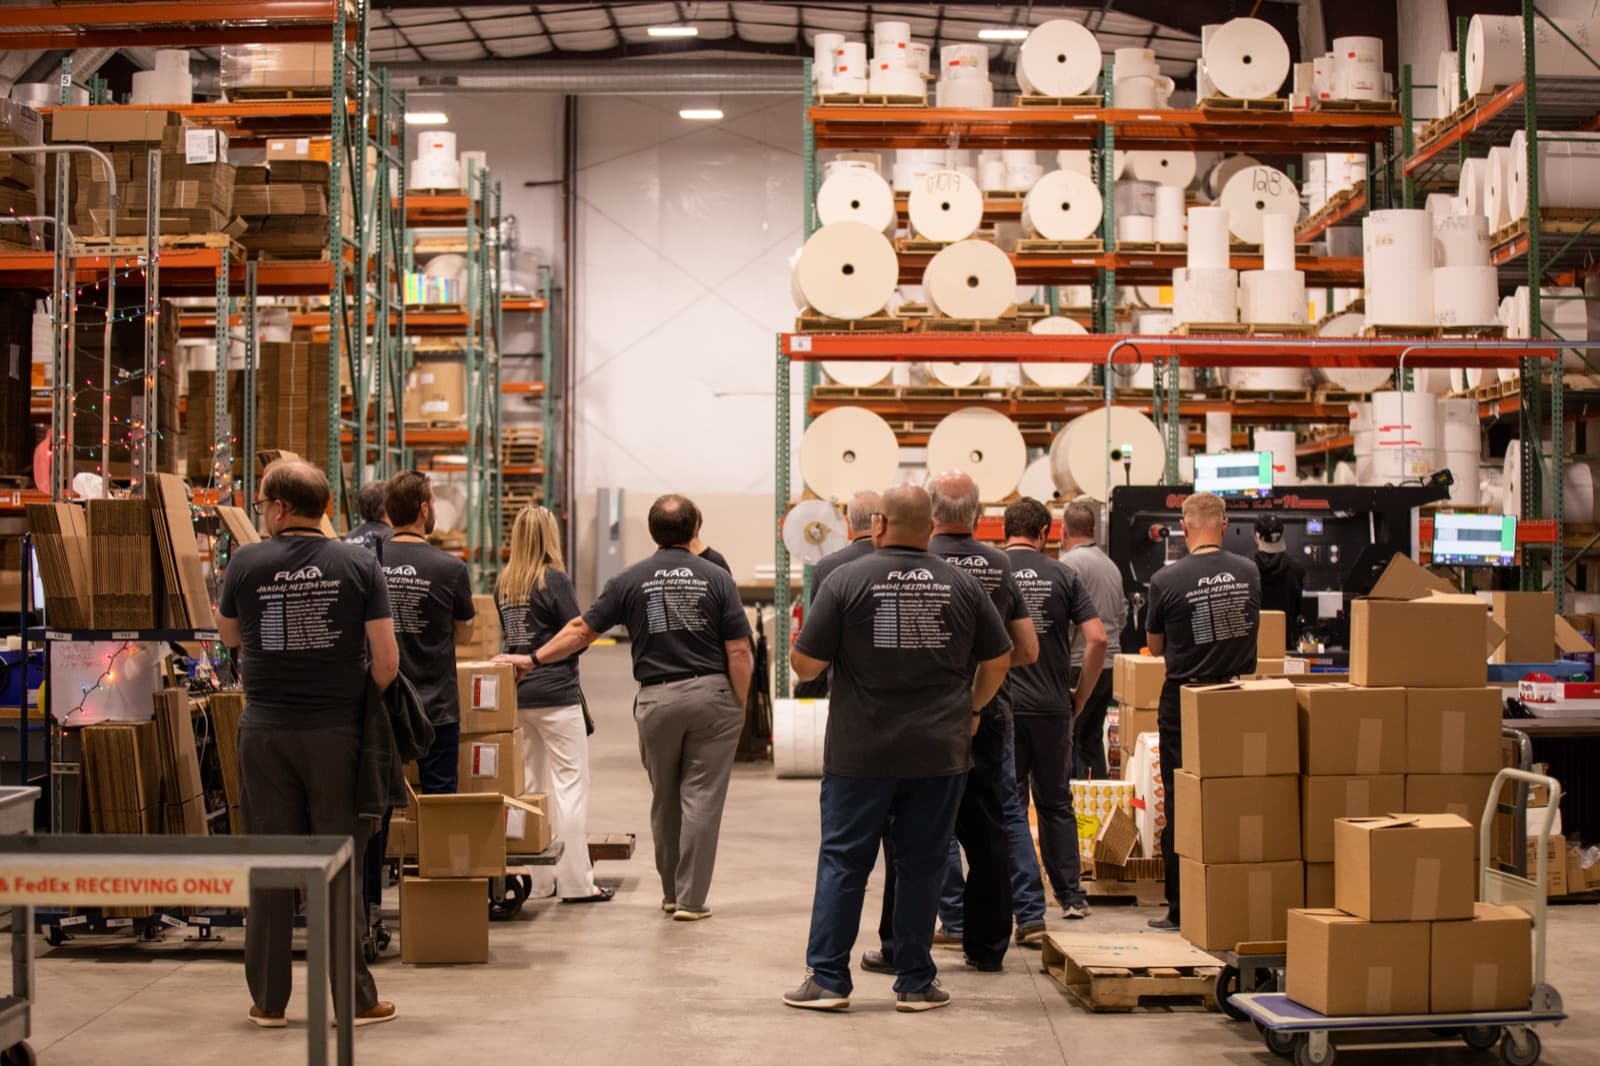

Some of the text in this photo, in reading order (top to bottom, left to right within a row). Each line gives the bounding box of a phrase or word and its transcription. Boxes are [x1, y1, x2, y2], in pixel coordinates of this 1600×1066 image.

[62, 75, 69, 84] 5
[1252, 168, 1282, 197] 128
[274, 566, 322, 582] FLAG
[654, 568, 694, 577] FLAG
[887, 568, 934, 581] FLAG
[1198, 572, 1235, 587] FLAG
[14, 876, 71, 893] FedEx
[75, 878, 178, 894] RECEIVING
[183, 878, 235, 894] ONLY
